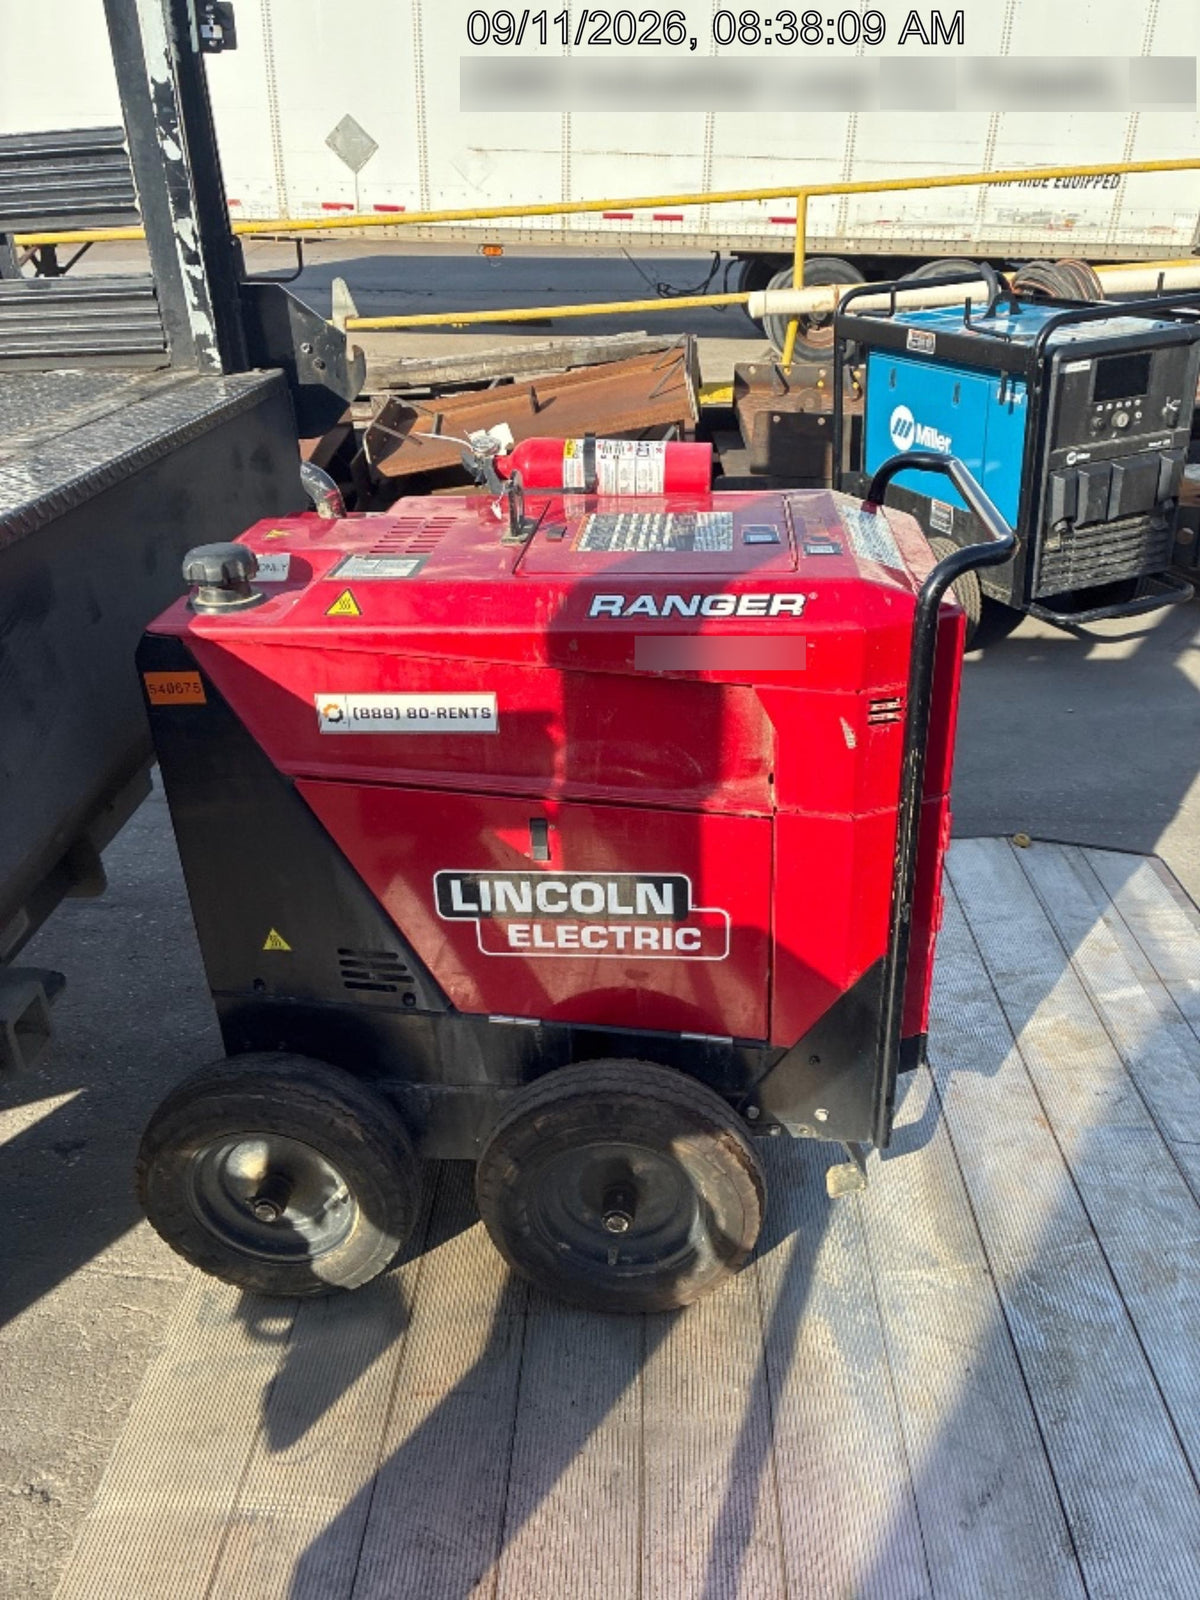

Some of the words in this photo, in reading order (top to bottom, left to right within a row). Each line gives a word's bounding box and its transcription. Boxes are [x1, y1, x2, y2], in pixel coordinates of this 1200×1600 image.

[352, 706, 401, 720] (888)
[406, 706, 492, 720] 80-RENTS
[450, 879, 675, 915] LINCOLN
[507, 923, 702, 951] ELECTRIC
